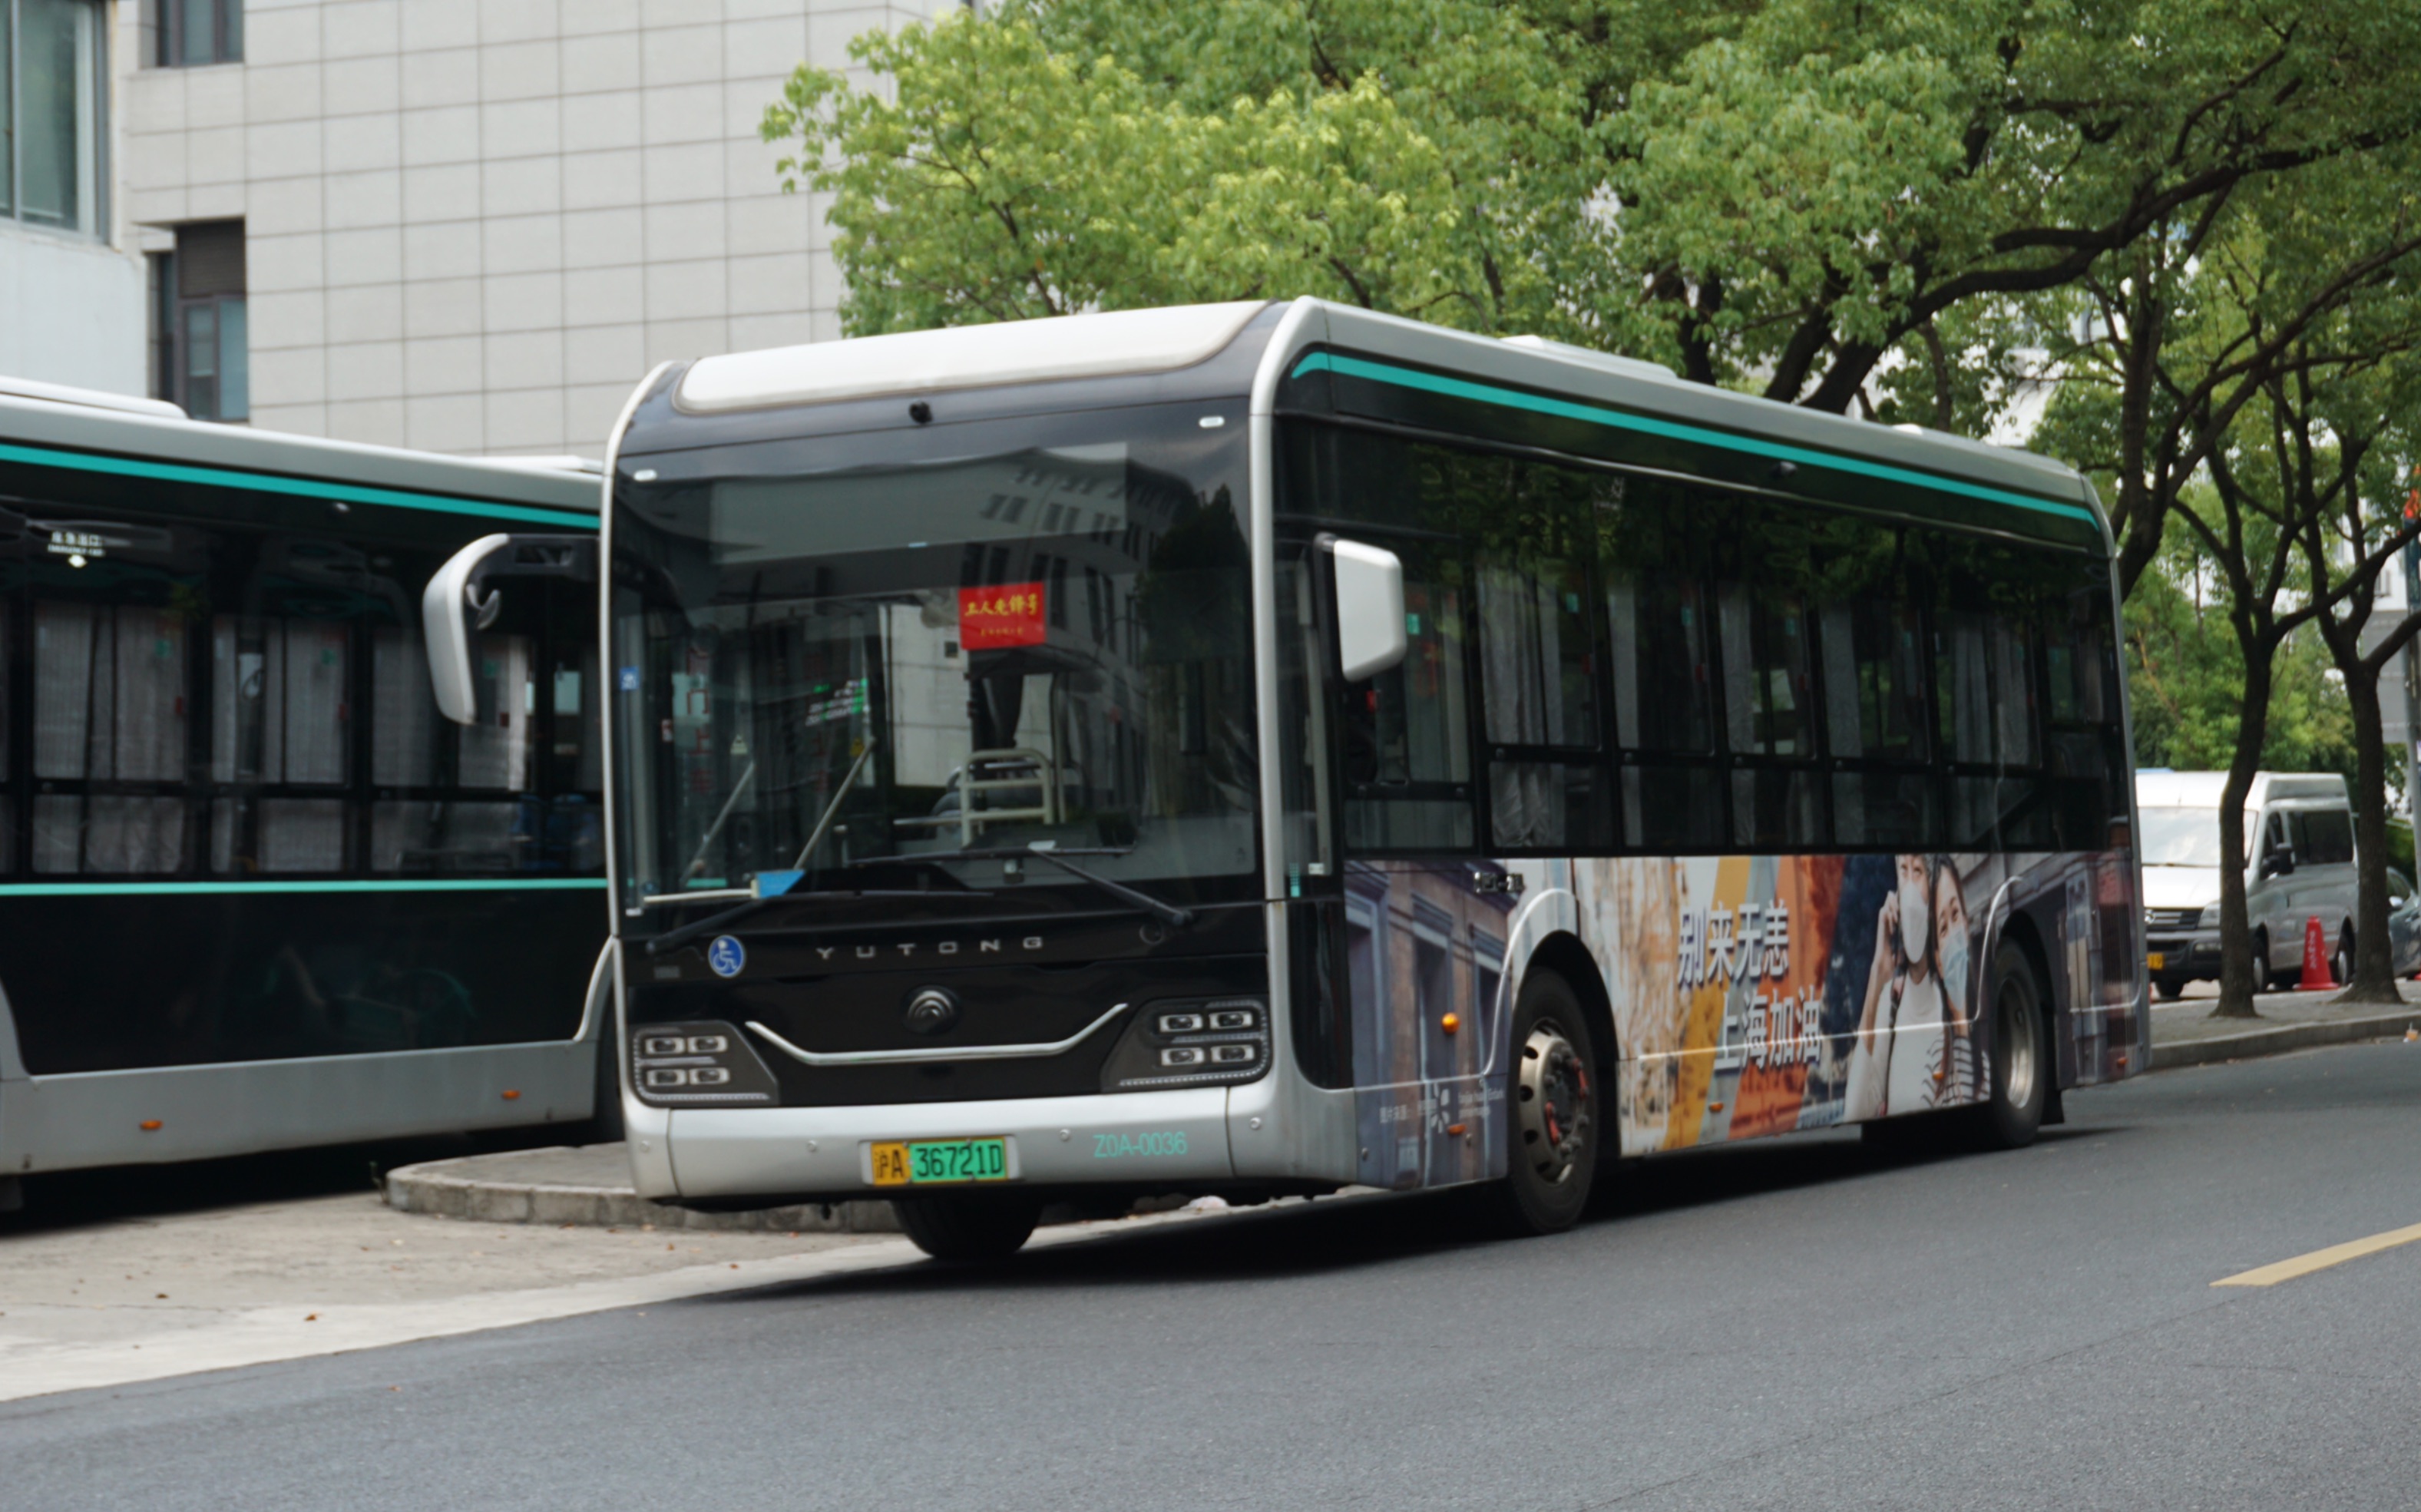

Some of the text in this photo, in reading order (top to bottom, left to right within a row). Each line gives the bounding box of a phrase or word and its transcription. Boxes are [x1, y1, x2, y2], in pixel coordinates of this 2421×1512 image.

[816, 937, 1042, 960] YUTONG
[1678, 900, 1790, 988] 别来无恙
[1713, 985, 1821, 1070] 上海加油
